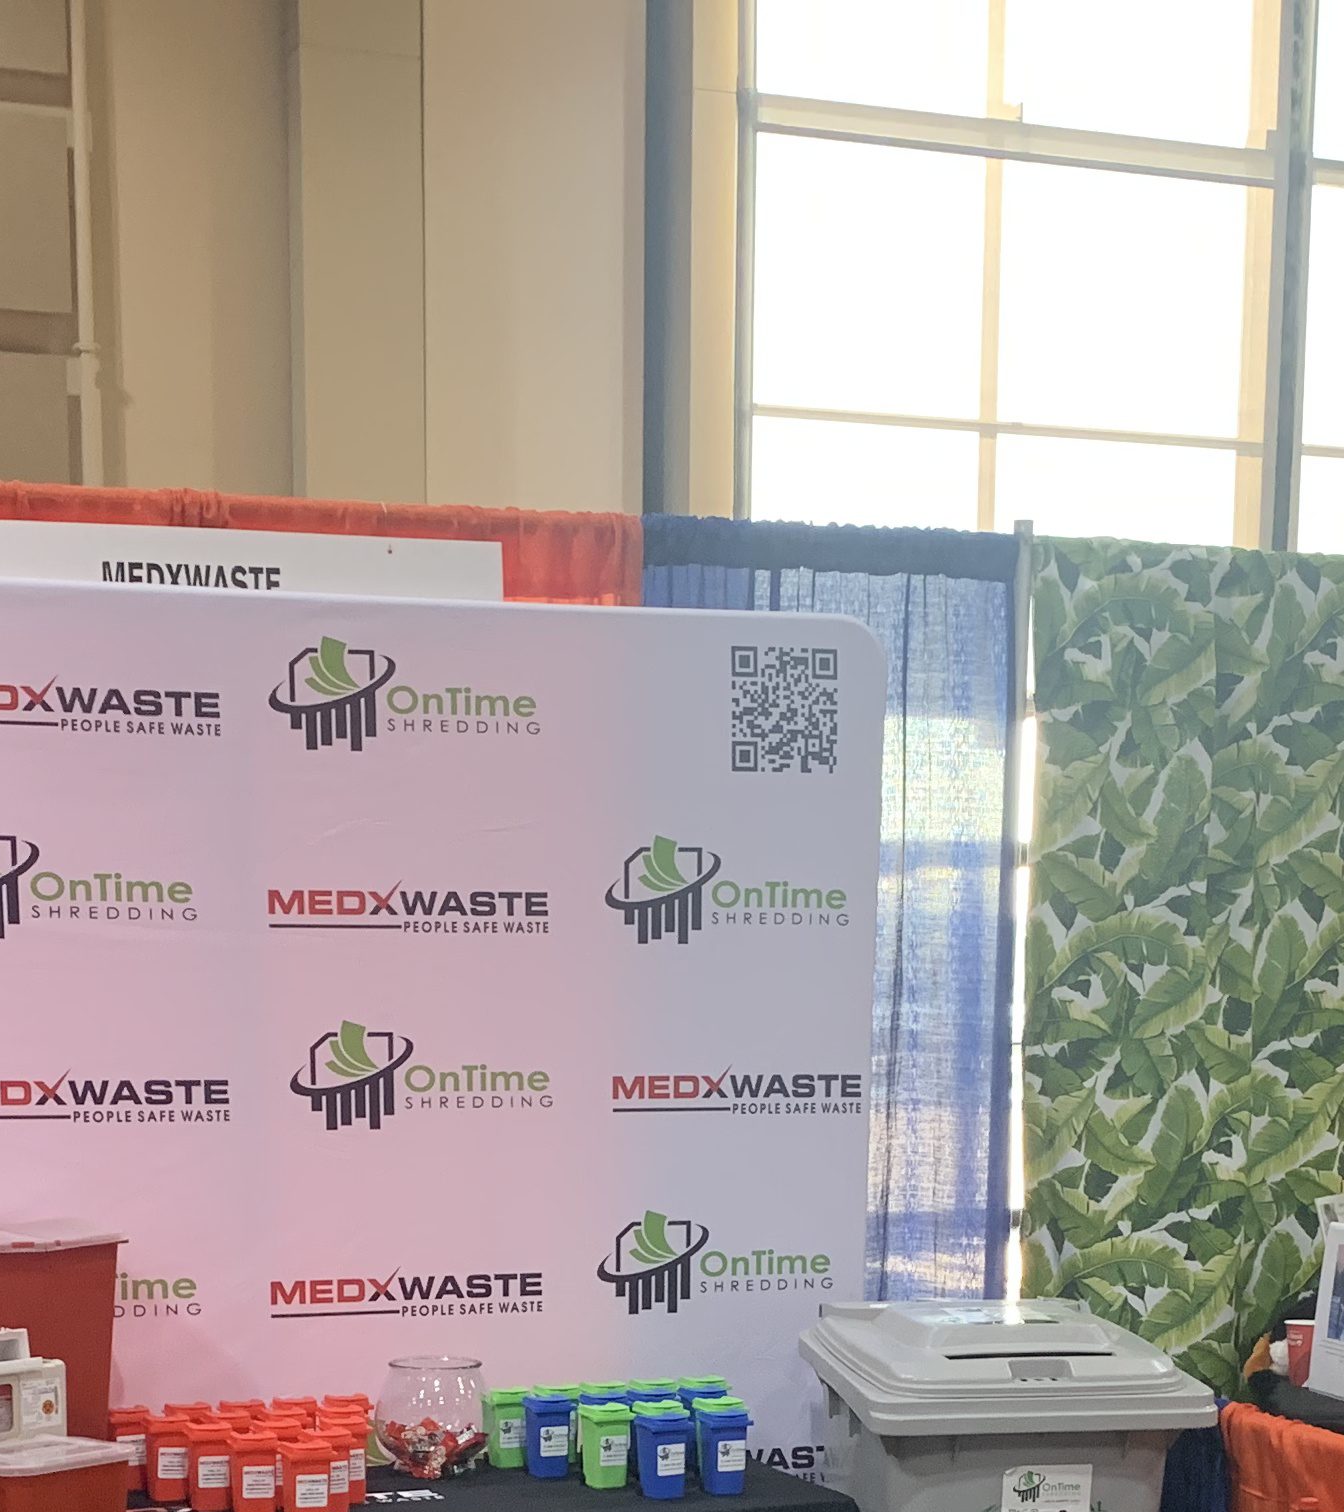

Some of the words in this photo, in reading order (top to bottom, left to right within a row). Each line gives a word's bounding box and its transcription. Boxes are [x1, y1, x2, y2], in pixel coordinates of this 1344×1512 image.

[386, 684, 537, 718] OnTime
[60, 718, 120, 734] PEOPLE
[126, 720, 165, 735] SAFE
[170, 722, 221, 737] WASTE
[387, 718, 542, 735] SHREDDING
[30, 871, 193, 904] OnTime
[267, 880, 549, 917] MEDXWASTE
[711, 880, 848, 911] OnTime
[31, 904, 198, 922] SHREDDING
[712, 911, 849, 927] SHREDDING
[404, 1063, 550, 1095] OnTime
[612, 1064, 862, 1099] MEDXWASTE
[404, 1094, 553, 1110] SHREDDING
[700, 1248, 831, 1276] OnTime
[270, 1266, 543, 1305] MEDXWASTE
[700, 1276, 833, 1293] SHREDDING
[401, 1304, 454, 1318] PEOPLE
[458, 1303, 494, 1316] SAFE
[499, 1301, 543, 1314] WASTE
[1042, 1482, 1081, 1492] OnTime
